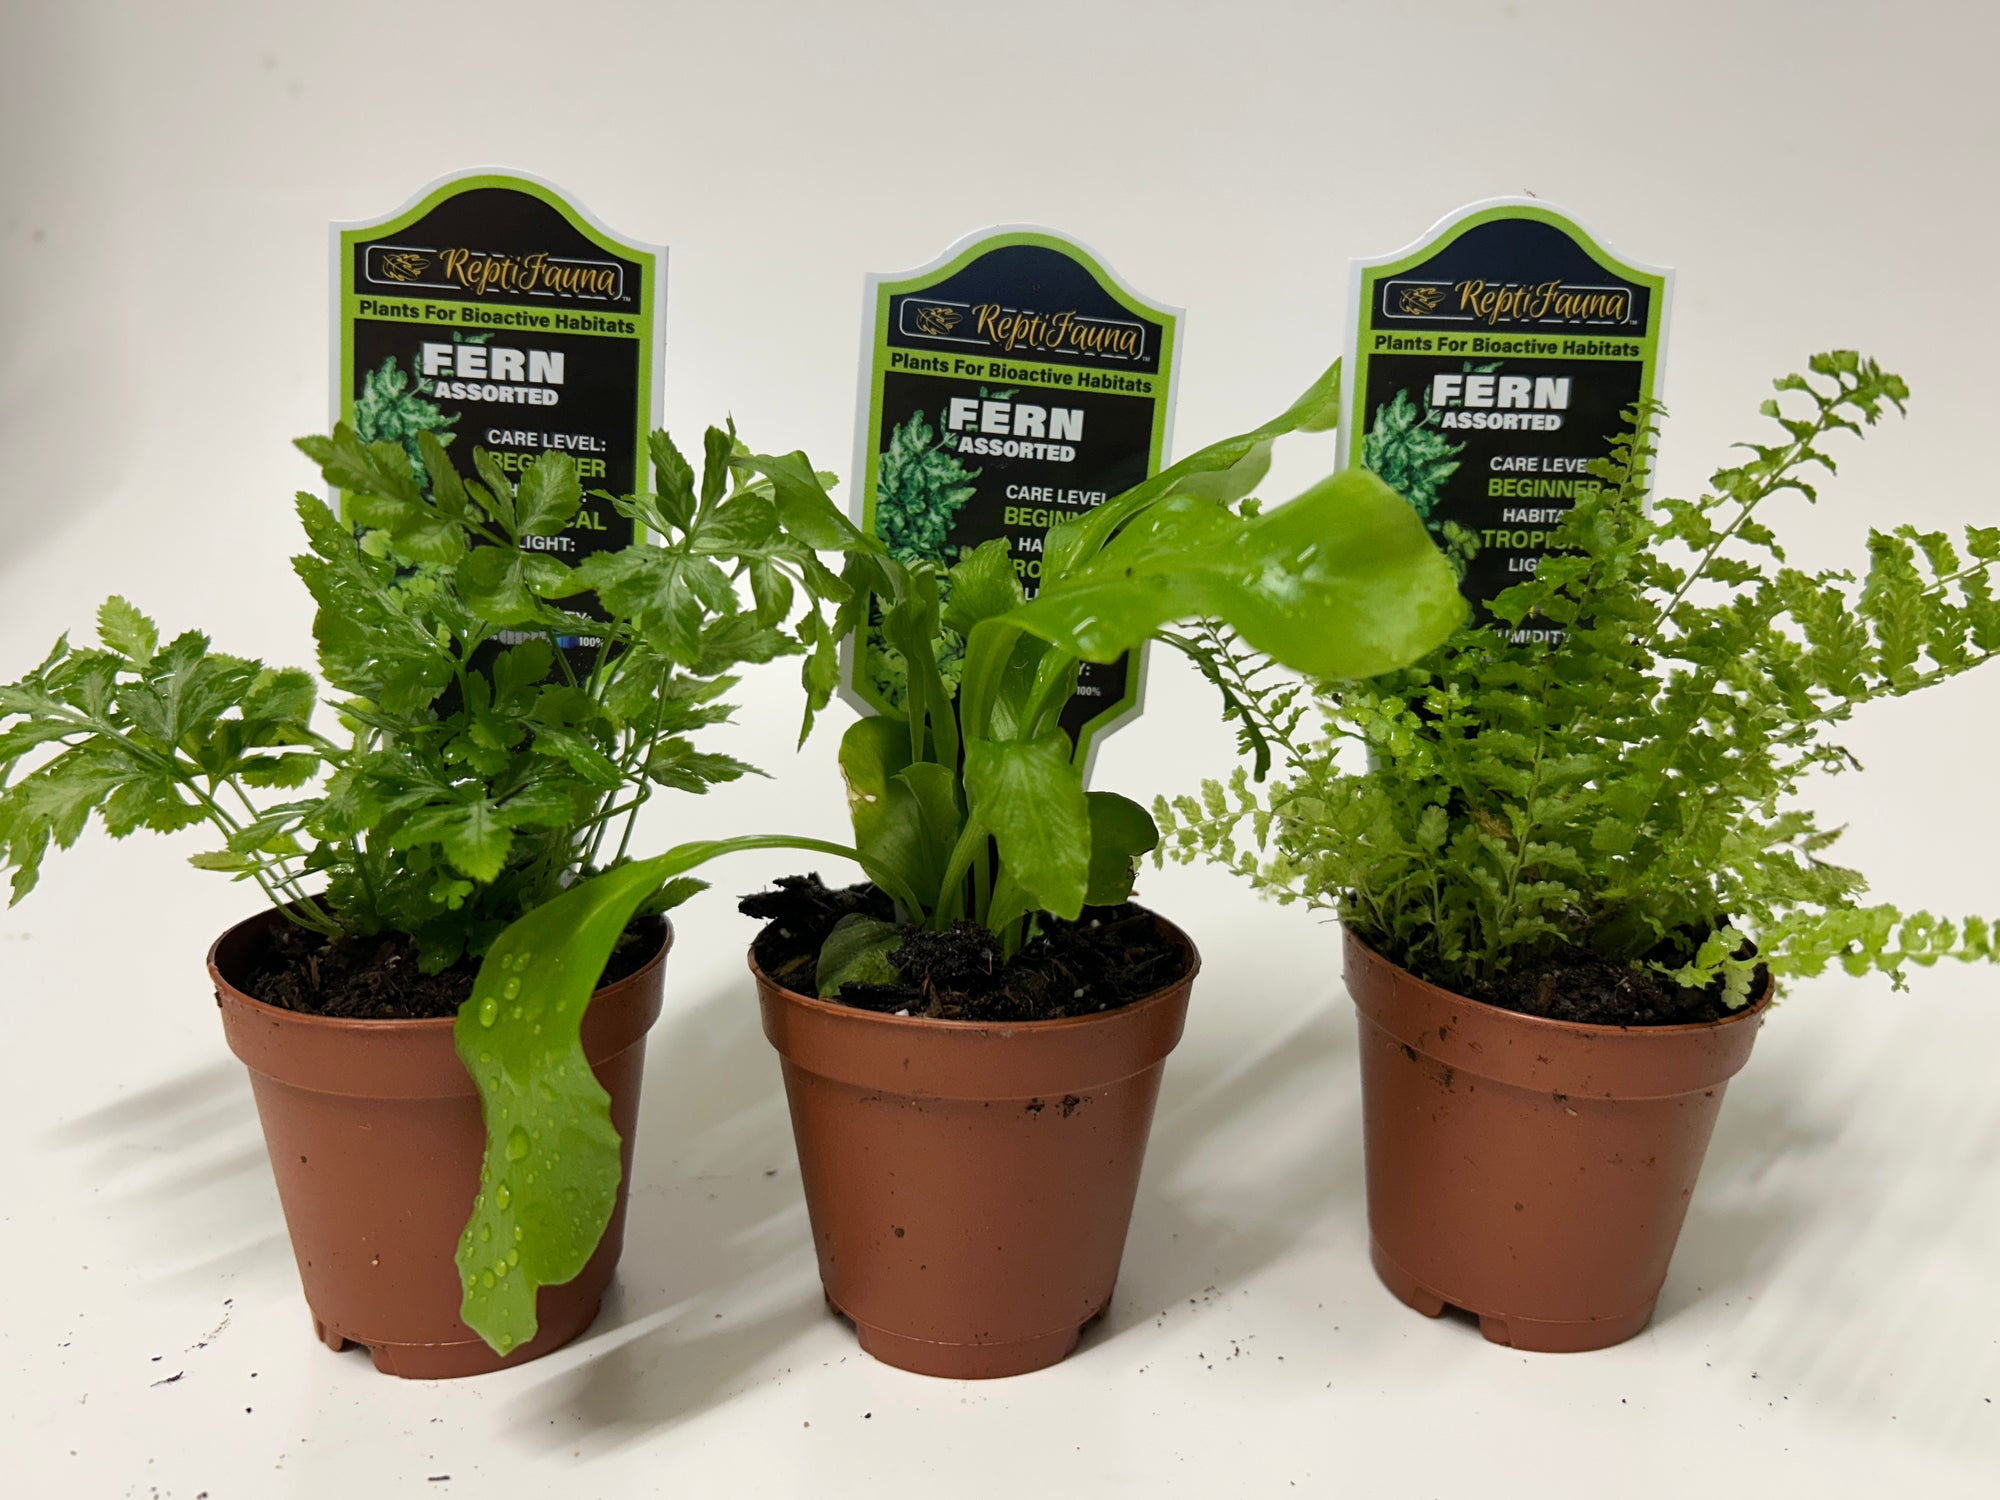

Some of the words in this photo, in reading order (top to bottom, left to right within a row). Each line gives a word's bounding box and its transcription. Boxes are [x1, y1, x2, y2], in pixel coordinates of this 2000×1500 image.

[440, 248, 616, 295] ReptiFauna
[1455, 279, 1624, 325] ReptiFauna
[359, 300, 420, 319] Plants
[425, 306, 457, 321] For
[461, 308, 550, 328] Bioactive
[555, 314, 635, 334] Habitats
[972, 304, 1138, 355] ReptiFauna
[1374, 334, 1432, 351] Plants
[1437, 336, 1467, 352] For
[1472, 337, 1557, 355] Bioactive
[1562, 340, 1640, 357] Habitats
[422, 343, 565, 385] FERN
[891, 352, 949, 374] Plants
[954, 359, 984, 377] For
[989, 363, 1073, 386] Bioactive
[1077, 373, 1152, 394] Habitats
[434, 381, 559, 406] ASSORTED
[1431, 374, 1571, 410] FERN
[948, 397, 1085, 441] FERN
[1441, 411, 1562, 431] ASSORTED
[488, 429, 538, 447] CARE
[543, 433, 606, 452] LEVEL:
[958, 436, 1076, 462] ASSORTED
[488, 451, 606, 478] BEGER
[1489, 456, 1538, 472] CARE
[1542, 458, 1589, 473] LEVE
[1005, 484, 1053, 502] CARE
[1057, 489, 1106, 506] LEVEL
[1004, 506, 1080, 527] BEGIN
[1502, 508, 1565, 523] HABITA
[1508, 558, 1538, 572] LIG
